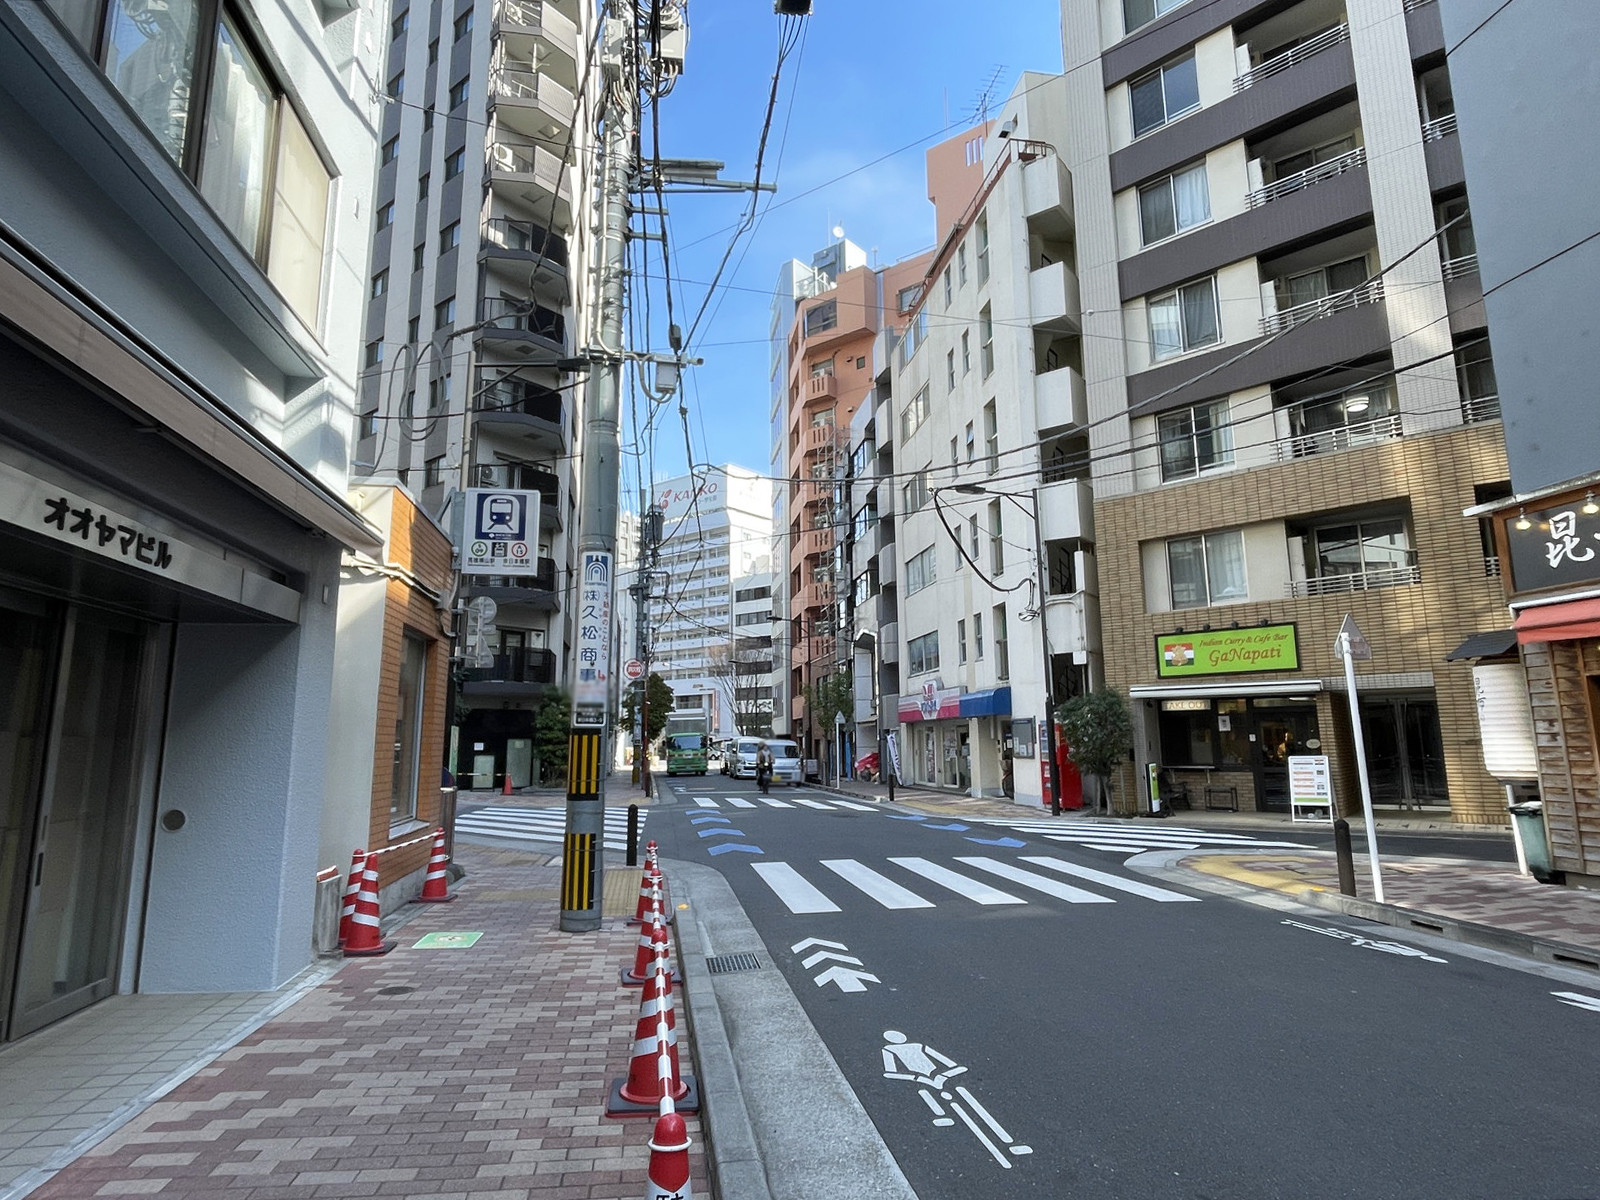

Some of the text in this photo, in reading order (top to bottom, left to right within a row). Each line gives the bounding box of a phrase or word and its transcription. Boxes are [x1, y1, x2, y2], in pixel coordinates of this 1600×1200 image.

[44, 497, 172, 569] オオヤマビル
[1545, 511, 1600, 568] 昆
[1209, 645, 1281, 666] GaNapati
[1273, 633, 1289, 641] Bar
